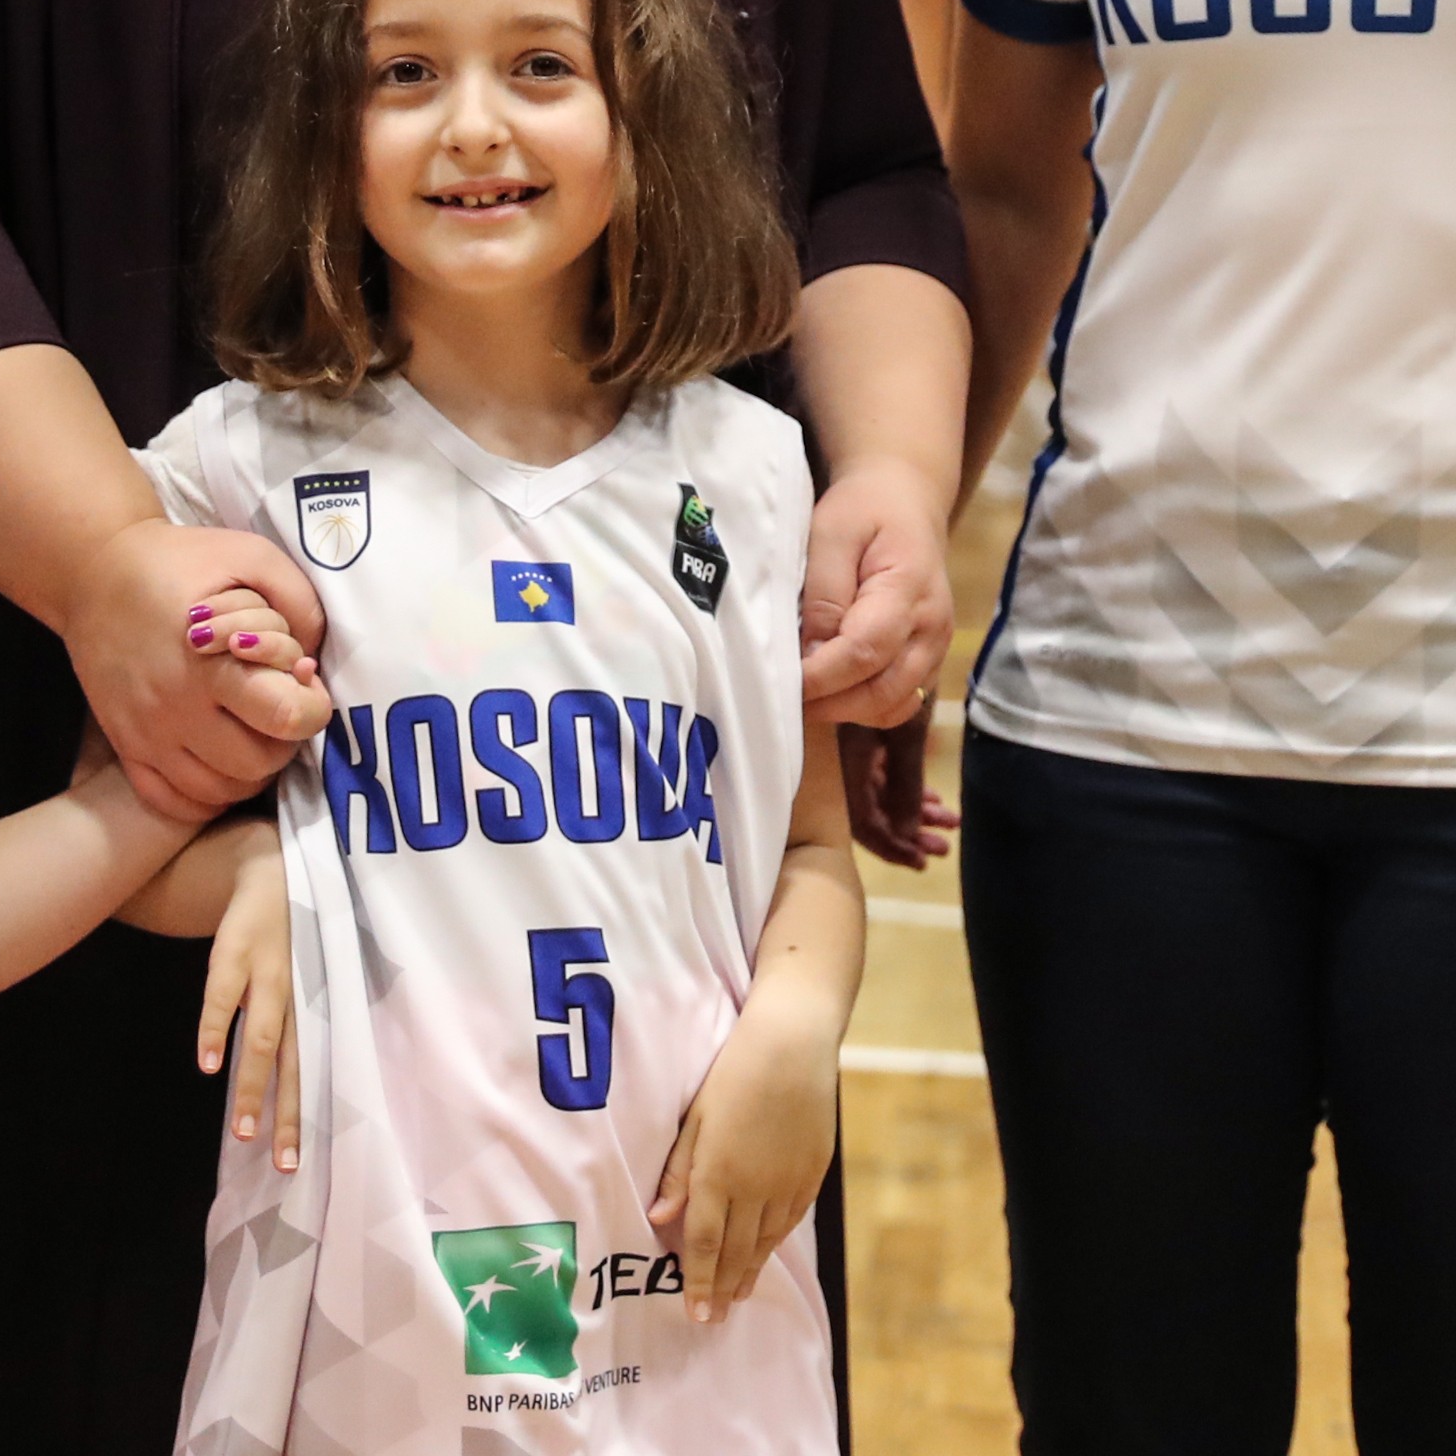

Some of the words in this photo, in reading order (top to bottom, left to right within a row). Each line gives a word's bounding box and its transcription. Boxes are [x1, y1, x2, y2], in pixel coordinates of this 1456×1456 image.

[307, 498, 361, 513] KOSOVA
[322, 688, 722, 865] KOSOVA
[526, 927, 615, 1112] 5
[590, 1252, 685, 1311] TEB
[467, 1394, 504, 1413] BNP
[585, 1366, 641, 1394] VENTURE
